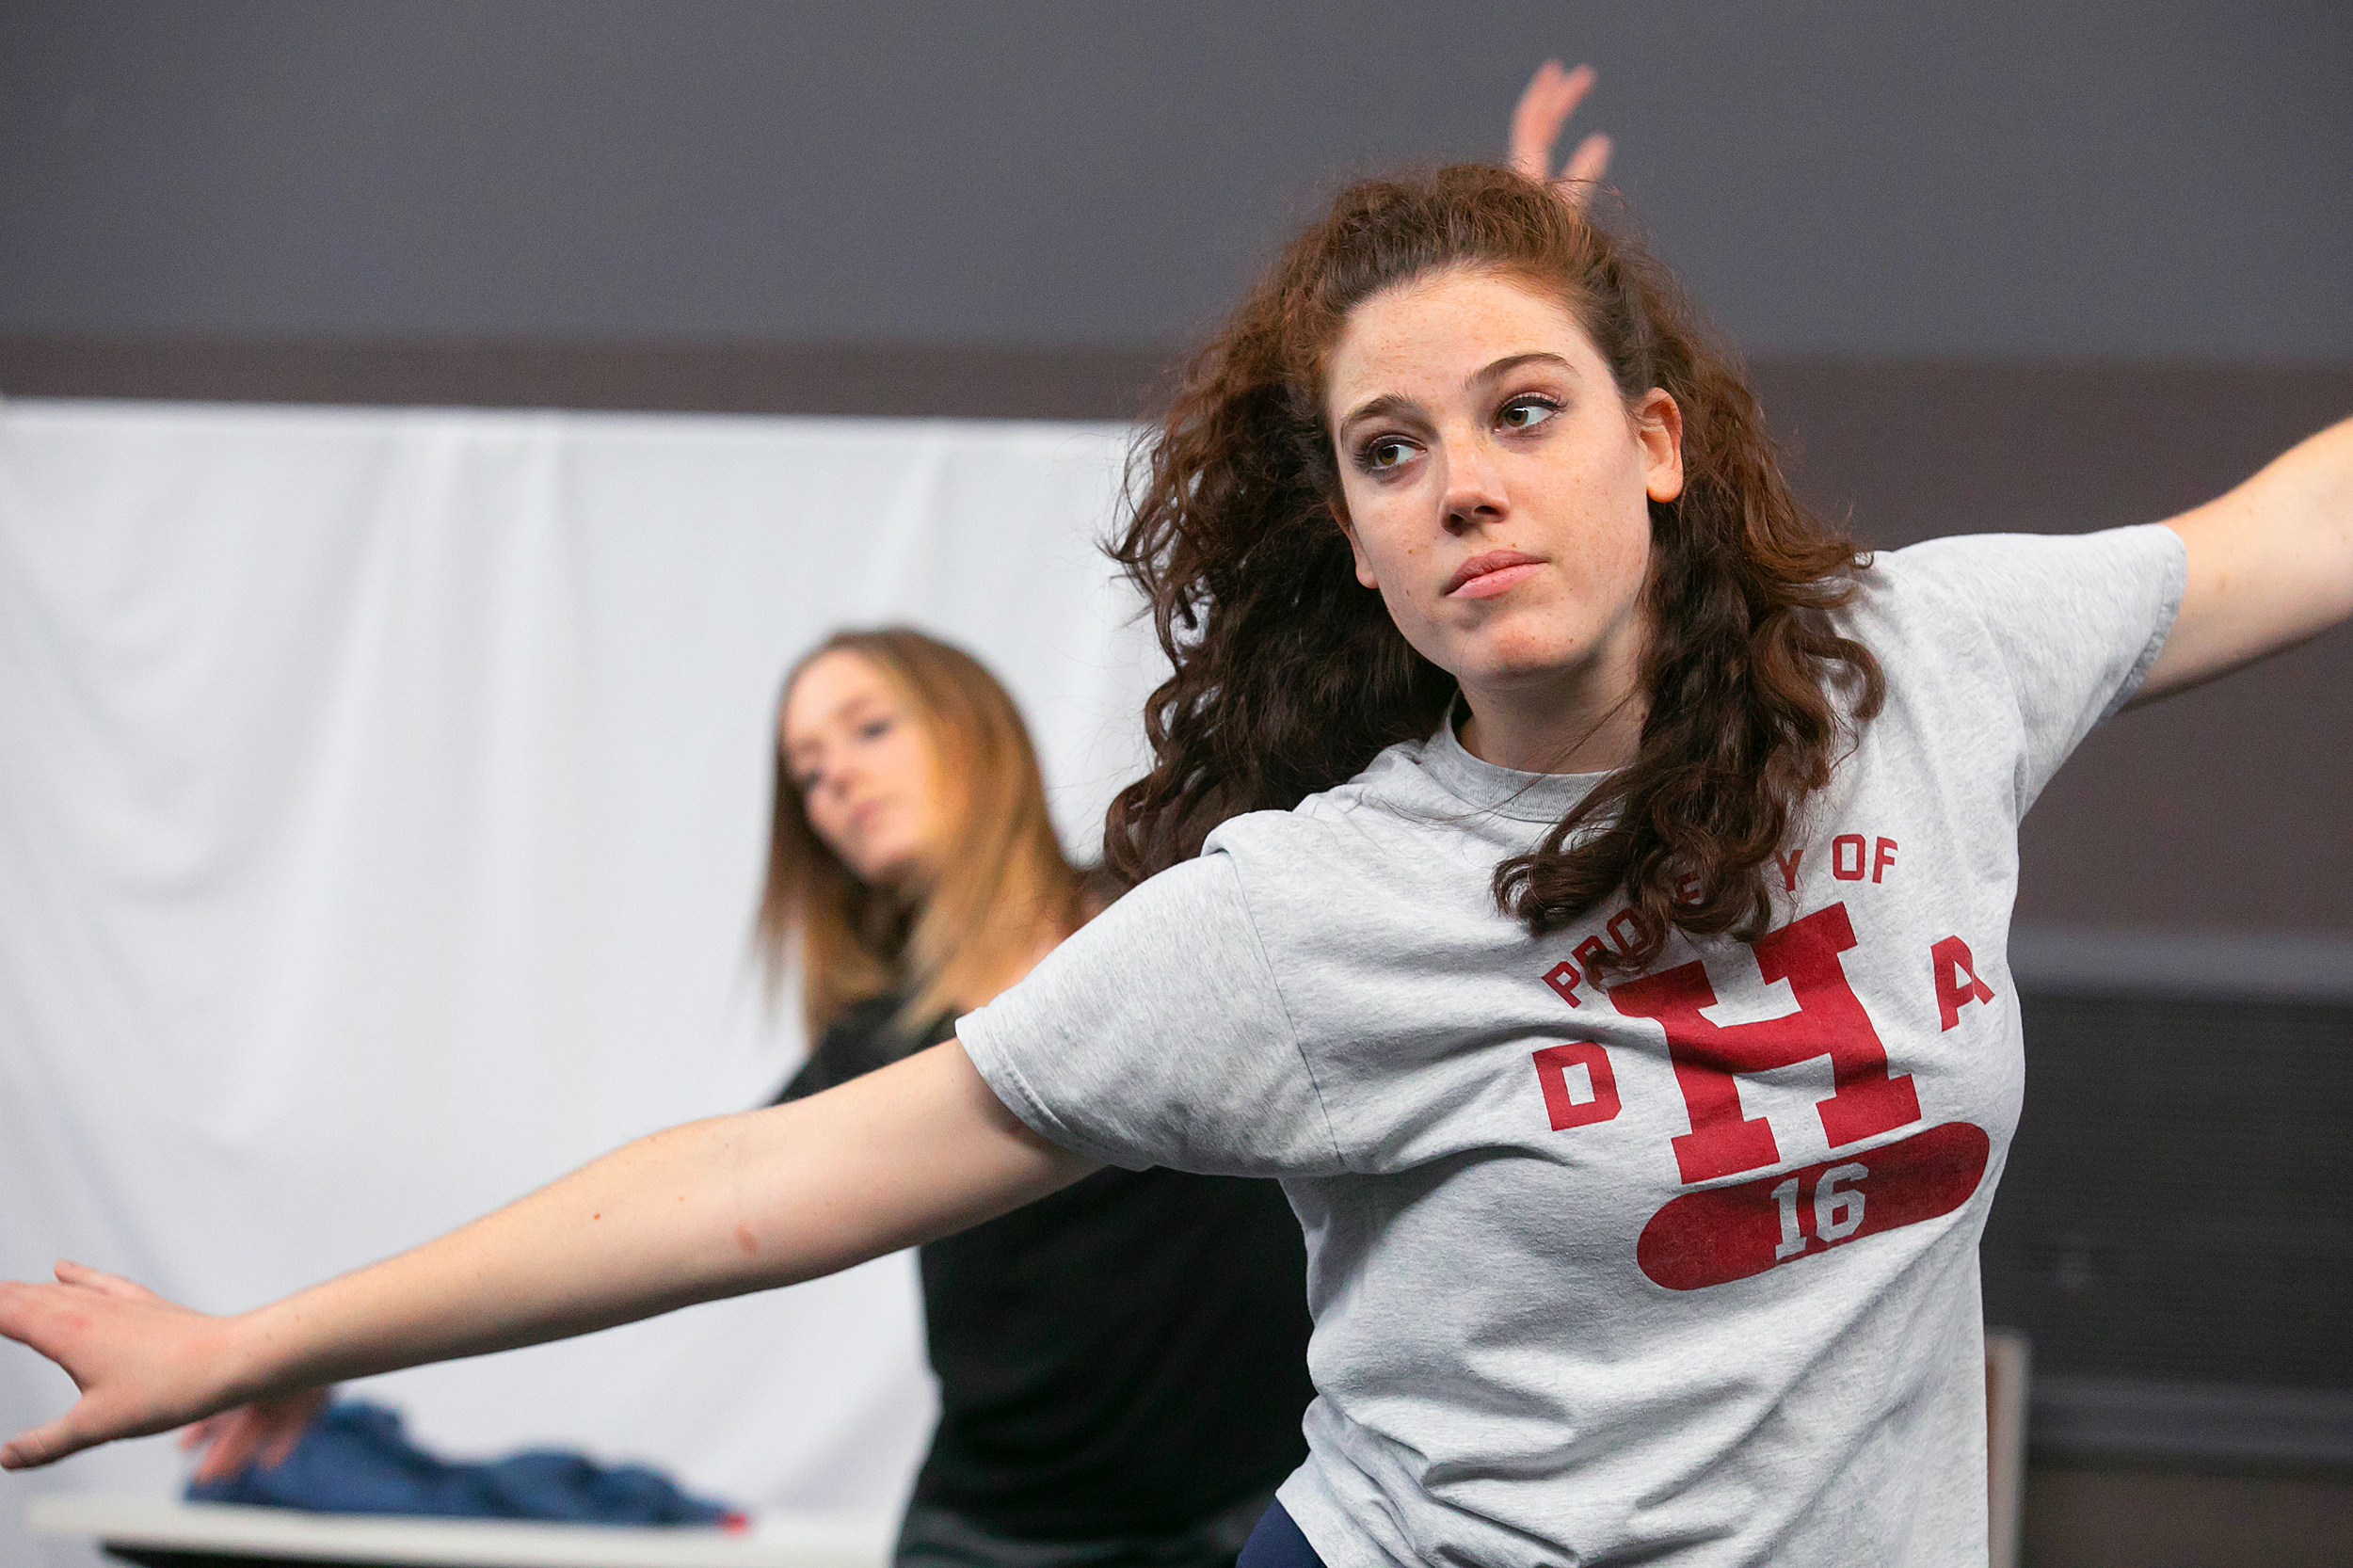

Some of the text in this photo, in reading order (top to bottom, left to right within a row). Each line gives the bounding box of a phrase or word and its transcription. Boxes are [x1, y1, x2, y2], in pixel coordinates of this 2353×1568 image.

[1832, 834, 1899, 884] OF
[1532, 902, 1996, 1184] D H A
[1770, 1162, 1869, 1261] 16
